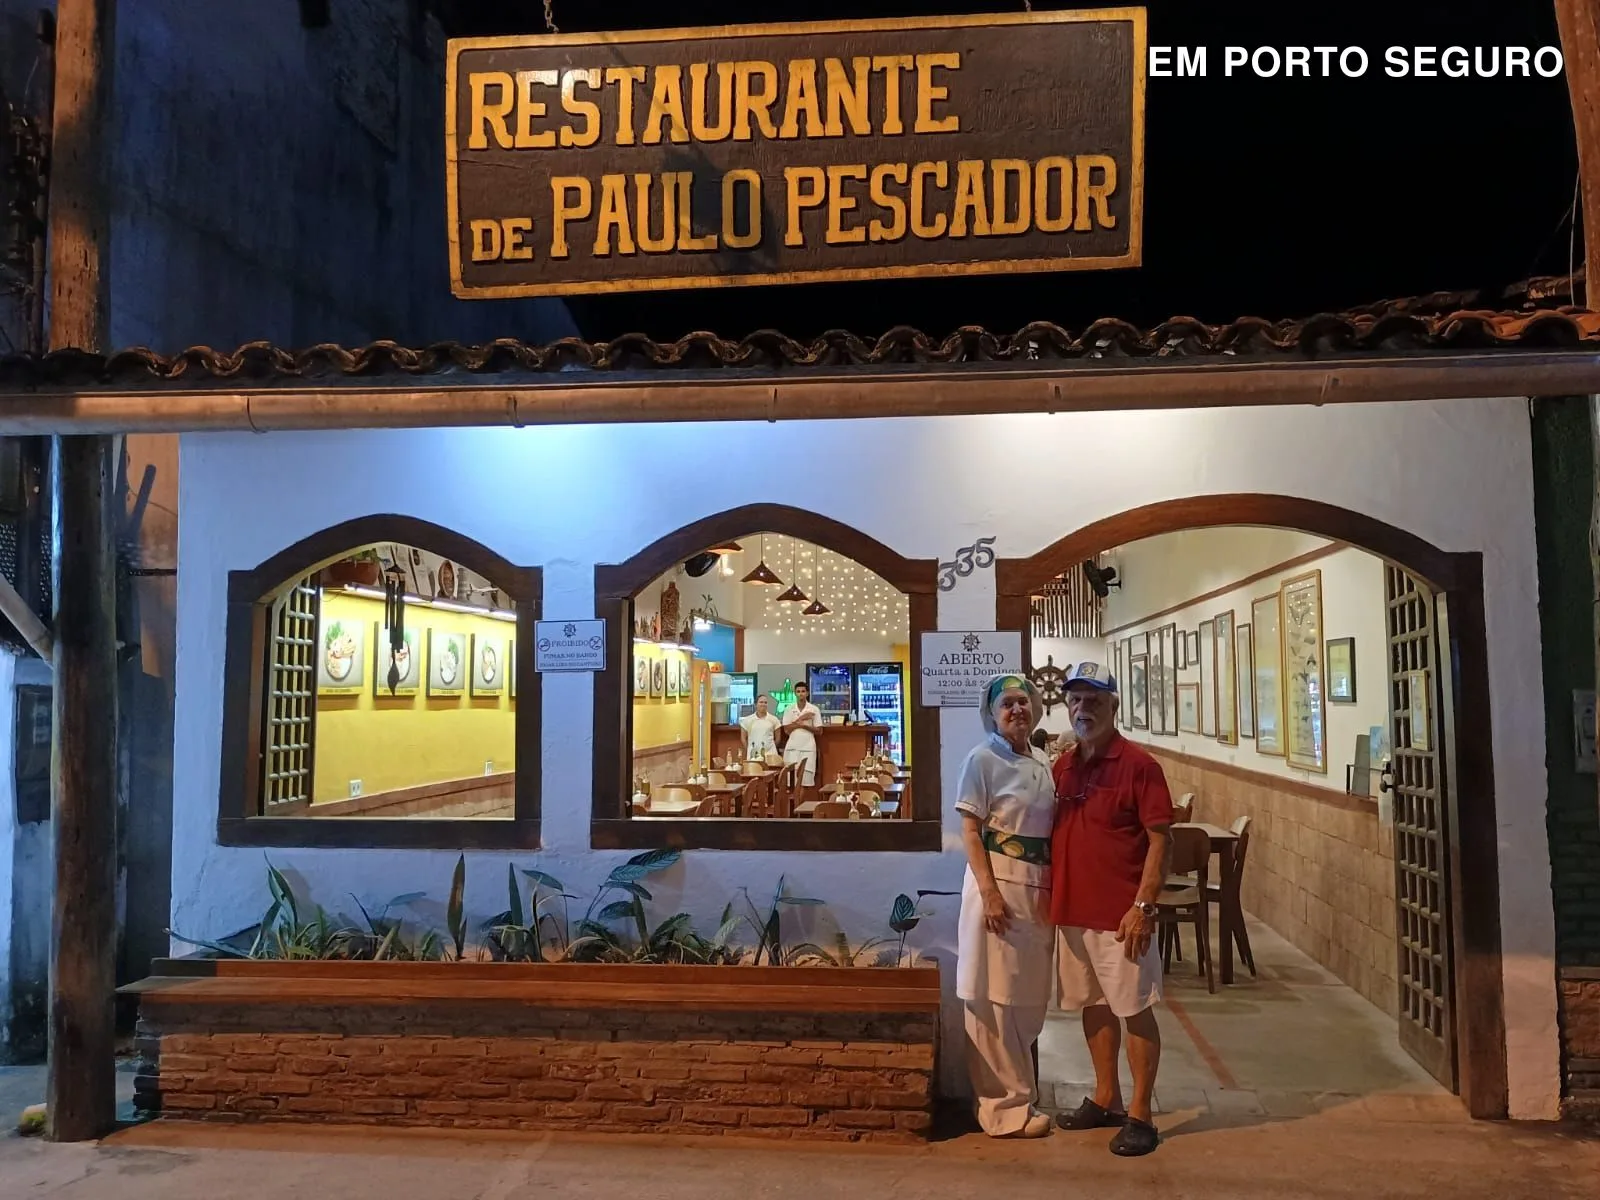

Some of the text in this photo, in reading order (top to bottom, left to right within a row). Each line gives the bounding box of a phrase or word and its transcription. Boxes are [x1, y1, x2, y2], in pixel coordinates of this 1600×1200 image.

[468, 53, 961, 149] RESTAURANTE
[470, 154, 1117, 262] DE PAULO PESCADOR
[938, 535, 997, 592] 335
[551, 640, 589, 648] PROIBIDO
[938, 653, 1004, 665] ABERTO
[922, 667, 962, 677] Quarta
